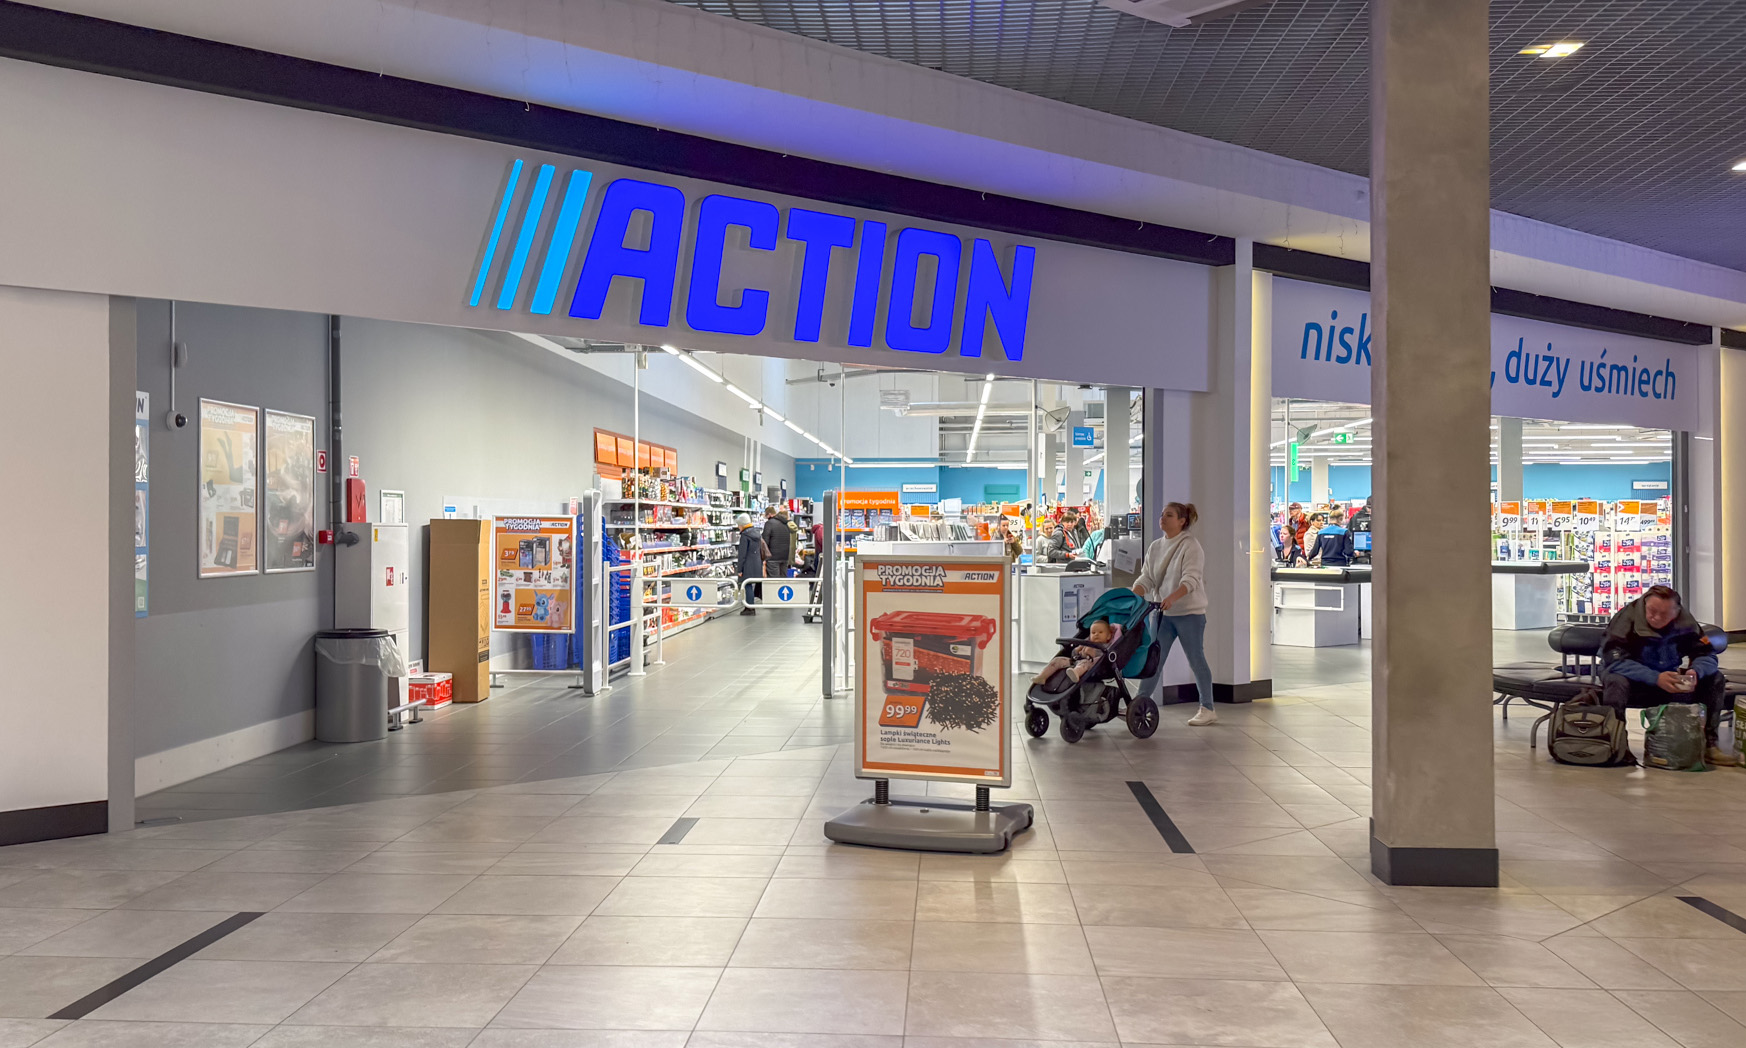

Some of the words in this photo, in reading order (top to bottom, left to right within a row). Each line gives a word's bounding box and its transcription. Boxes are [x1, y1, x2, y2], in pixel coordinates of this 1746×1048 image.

[569, 178, 1036, 361] ACTION
[1504, 337, 1570, 398] duży
[1579, 348, 1676, 400] uśmiech
[503, 518, 541, 526] PROMOCJA
[878, 565, 946, 577] PROMOCJA
[881, 575, 944, 587] TYGODNIA
[964, 572, 995, 581] ACTION
[895, 648, 911, 658] 720
[880, 729, 902, 737] Lampki
[903, 730, 937, 739] świąteczne
[931, 738, 951, 746] Lights
